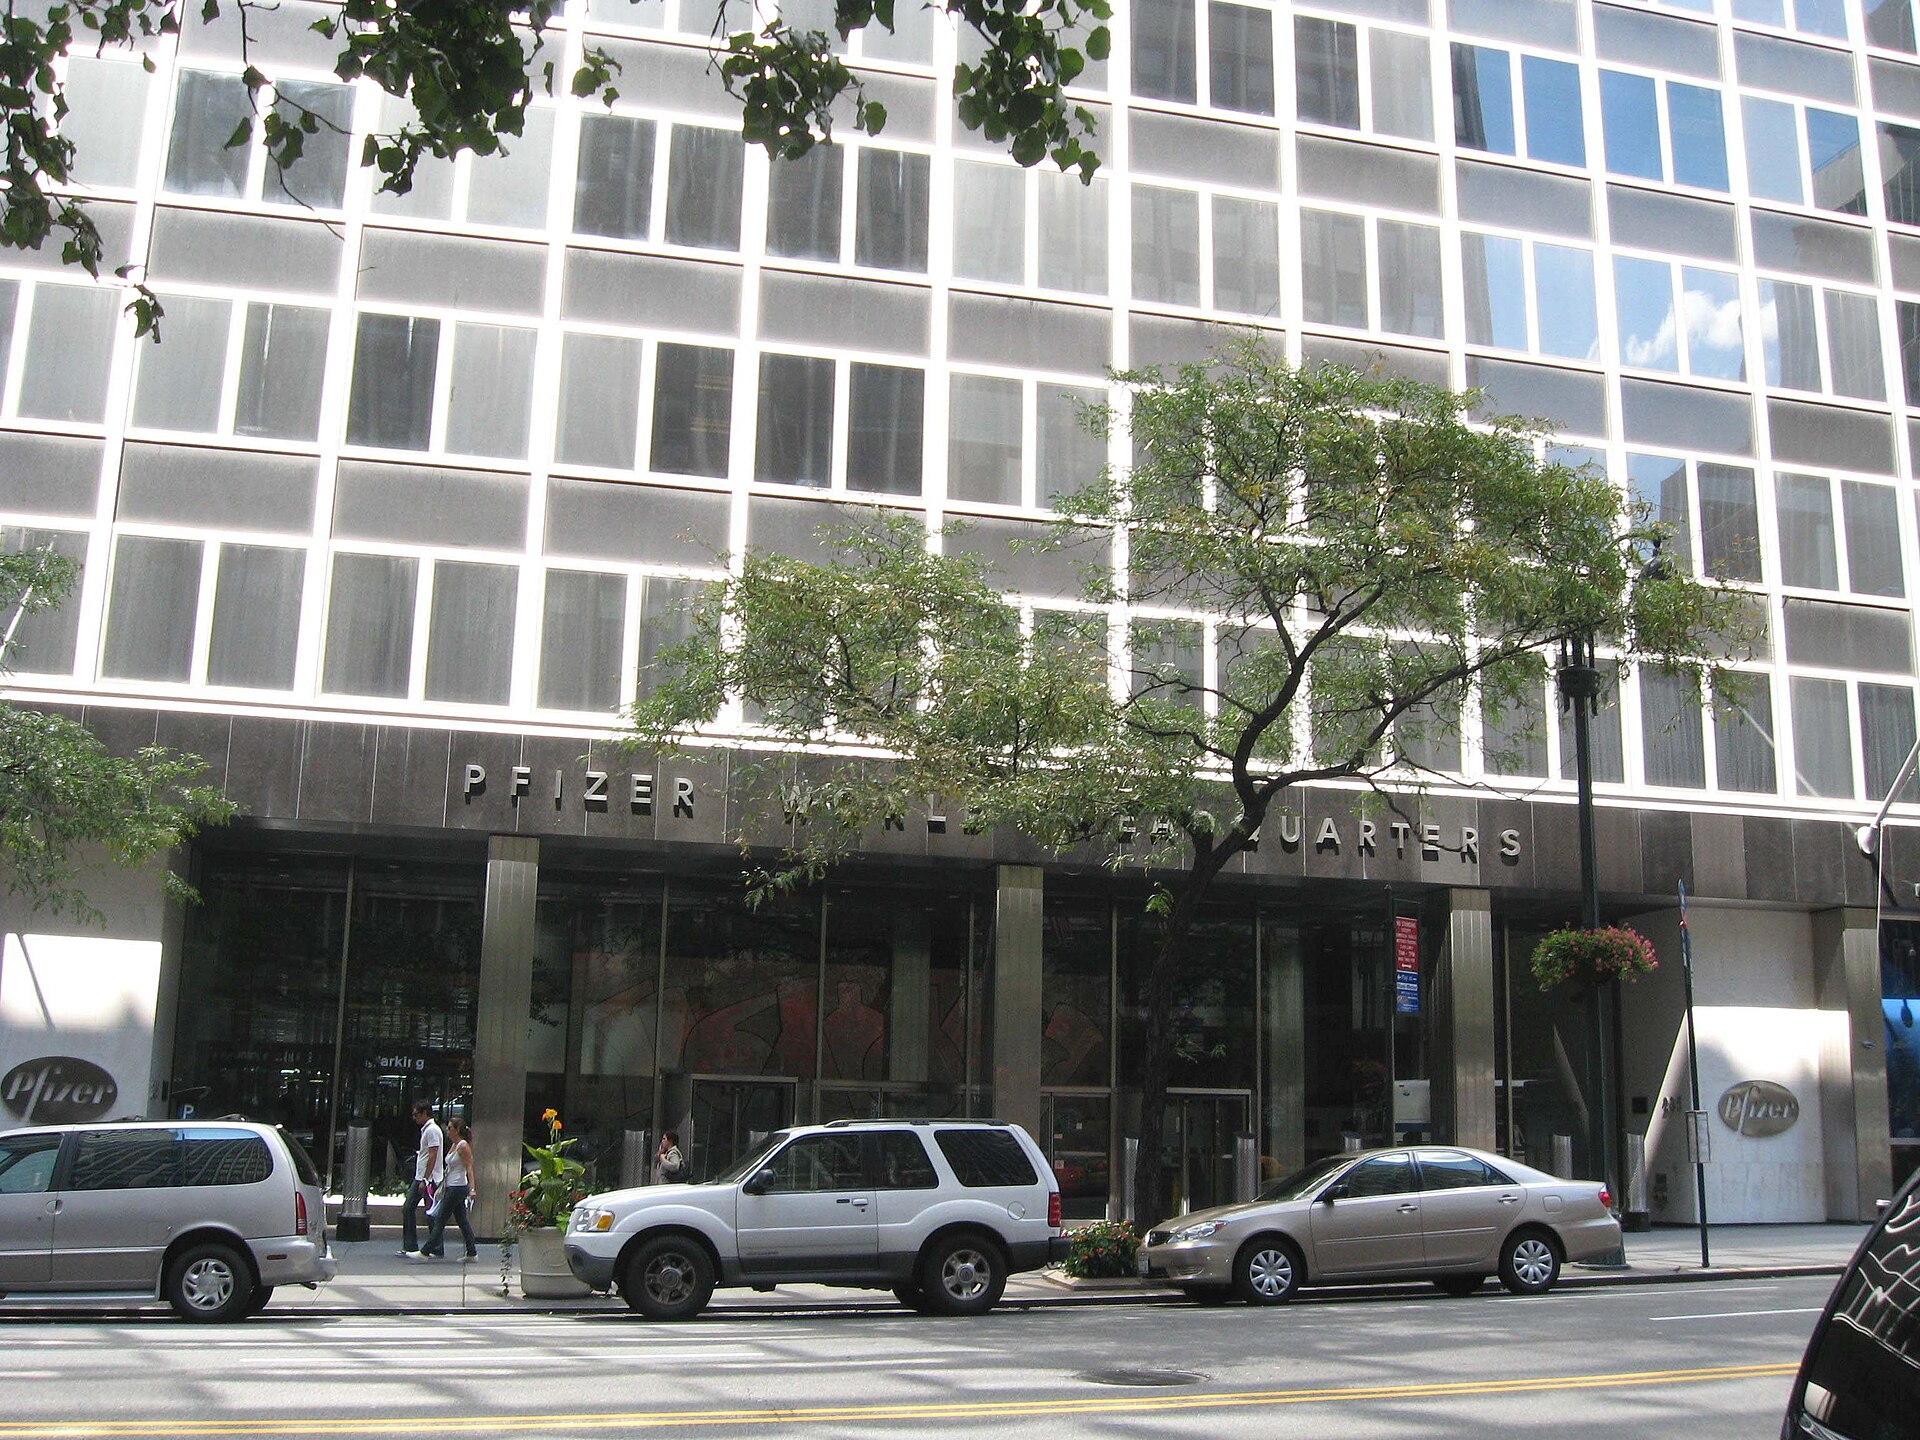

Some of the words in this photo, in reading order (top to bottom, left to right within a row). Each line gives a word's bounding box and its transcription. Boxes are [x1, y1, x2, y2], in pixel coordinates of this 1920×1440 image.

[464, 764, 695, 807] PFIZER
[6, 1066, 115, 1122] Pfizer
[1724, 1086, 1796, 1134] Pfizer
